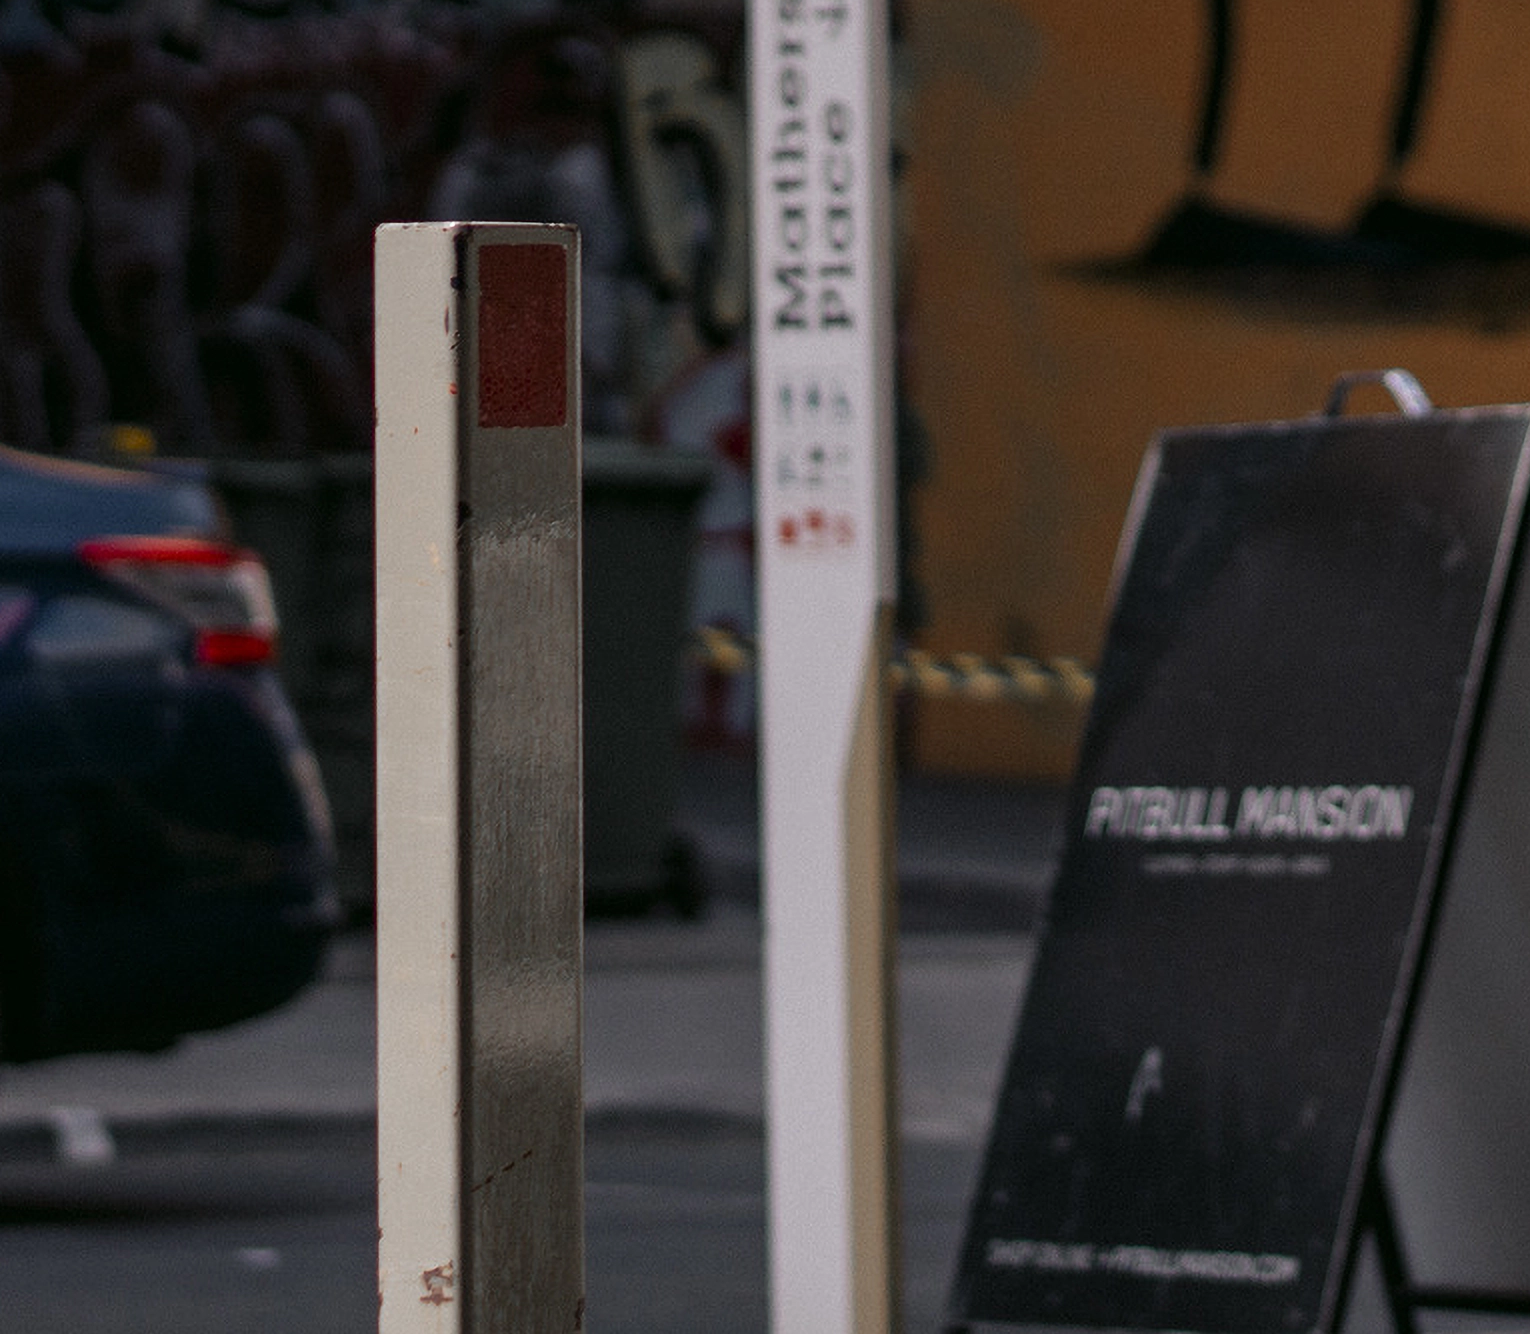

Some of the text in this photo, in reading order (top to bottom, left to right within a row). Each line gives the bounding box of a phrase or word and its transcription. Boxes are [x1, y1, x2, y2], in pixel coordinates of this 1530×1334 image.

[819, 103, 853, 329] Place
[1085, 783, 1414, 840] PITBULL MANSON
